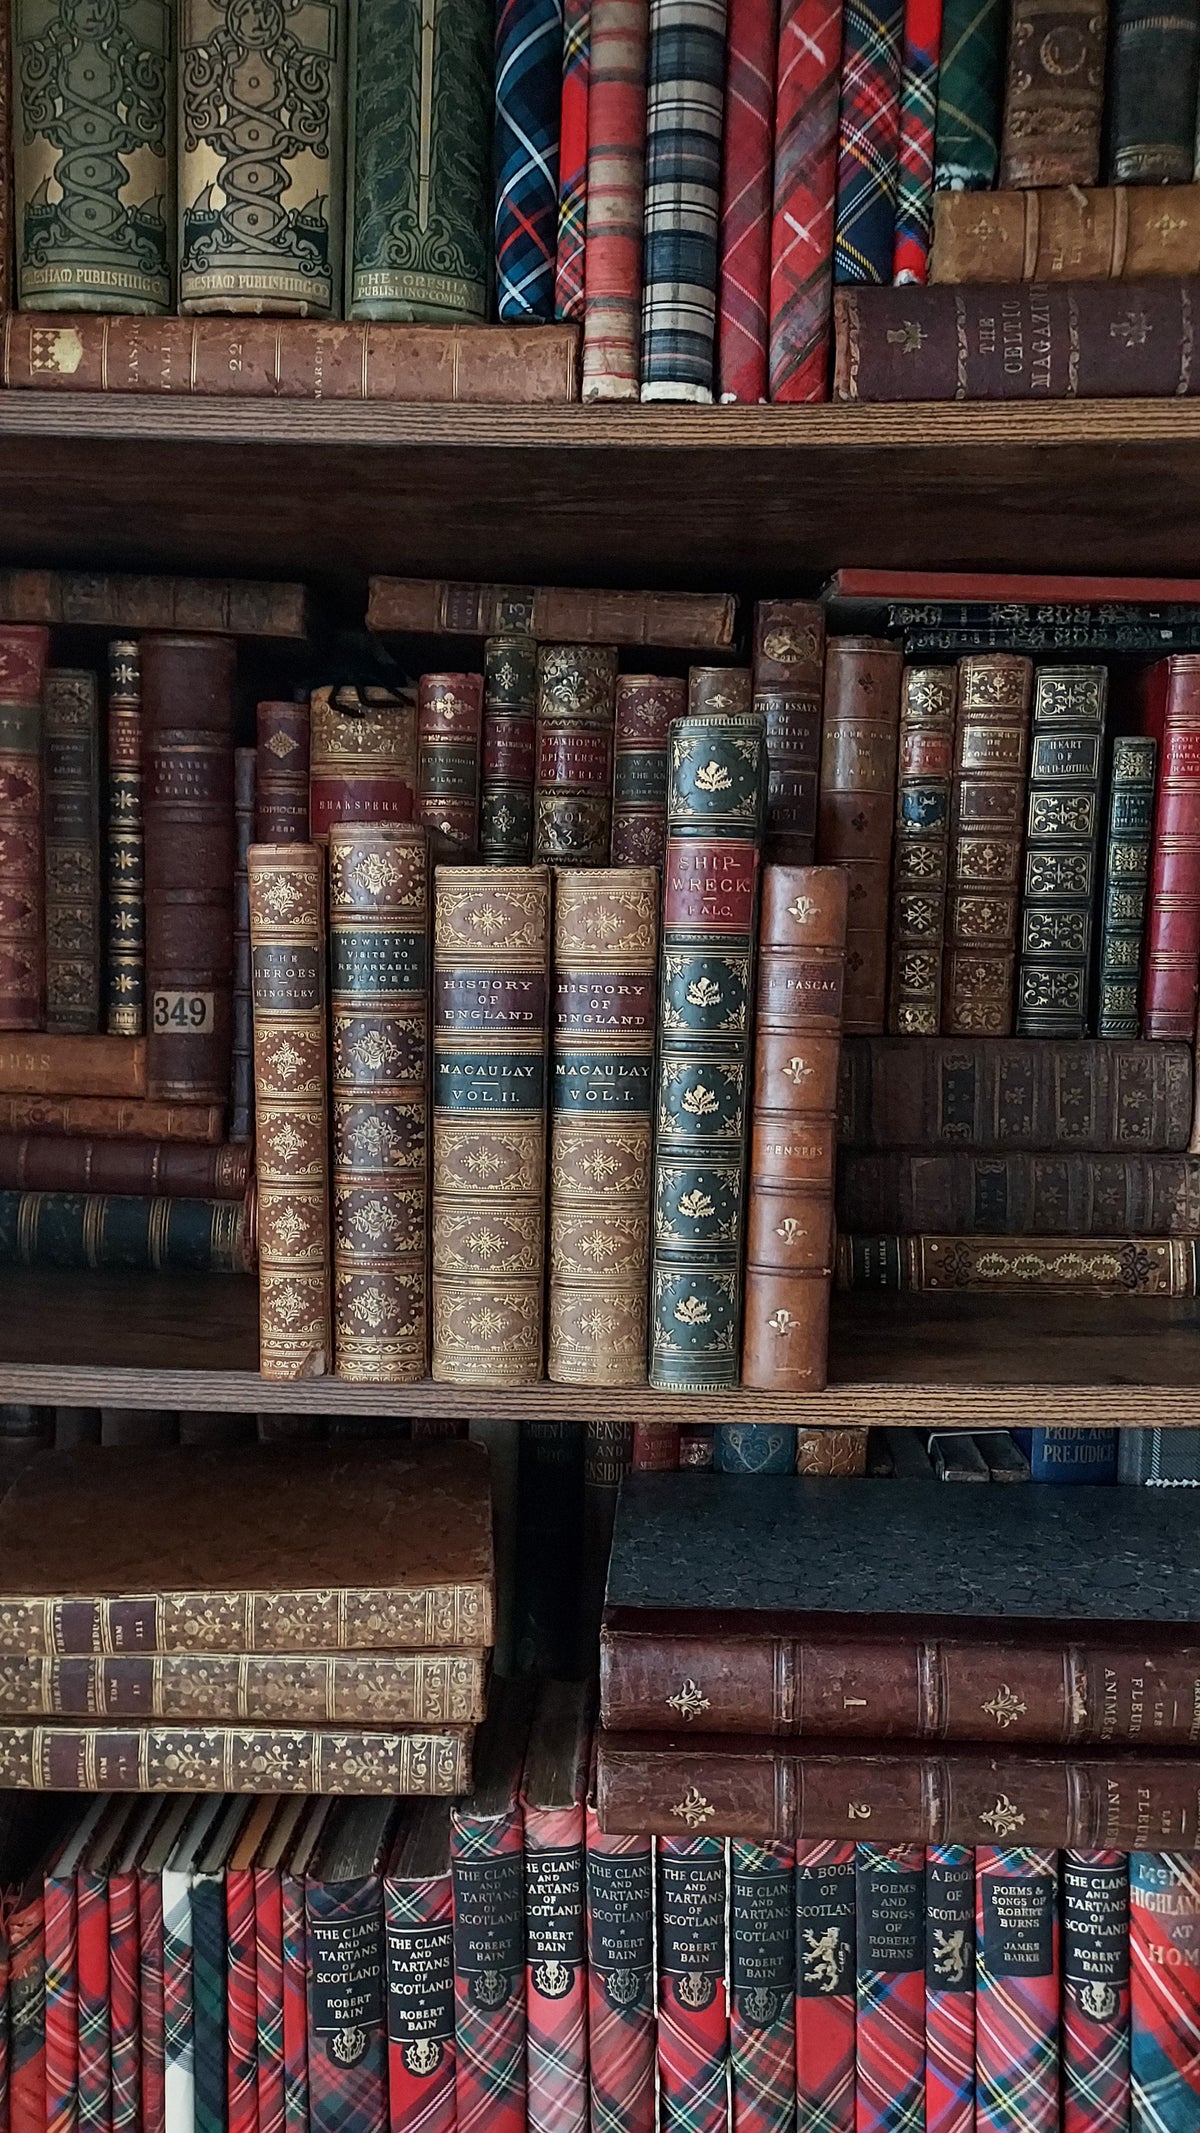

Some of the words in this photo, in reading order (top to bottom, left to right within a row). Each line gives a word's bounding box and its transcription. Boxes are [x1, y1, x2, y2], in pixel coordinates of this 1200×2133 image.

[76, 268, 150, 290] PUBLISHING
[239, 275, 311, 293] PUBLISHING
[358, 273, 391, 286] THE
[979, 318, 995, 354] THE
[1002, 300, 1023, 374] CELTIC
[229, 343, 242, 371] 22
[754, 702, 780, 712] PRIZE
[785, 702, 817, 713] ESSAYS
[778, 715, 790, 724] OF
[1050, 740, 1082, 750] HEART
[633, 758, 665, 768] WAR
[1057, 752, 1073, 762] OF
[631, 771, 649, 780] THE
[319, 800, 399, 811] SHAKSPERE
[679, 855, 741, 872] SHIP-
[688, 904, 734, 918] FALC.
[340, 937, 416, 947] HOWITT'S
[267, 953, 299, 964] THE
[347, 950, 386, 960] VISITS
[392, 950, 408, 960] TO
[254, 967, 317, 979] HEROES
[338, 962, 419, 972] REMARKABLE
[346, 973, 411, 984] PLACES
[443, 979, 534, 992] HISTORY
[557, 983, 646, 996] HISTORY
[787, 978, 837, 992] PASCAL
[256, 988, 316, 999] KINGSLEY
[477, 994, 500, 1006] OF
[590, 999, 612, 1010] OF
[154, 996, 207, 1027] 349
[444, 1009, 535, 1022] ENGLAND
[558, 1014, 647, 1026] ENGLAND
[439, 1063, 536, 1078] MACAULAY
[555, 1064, 651, 1078] MACAULAY
[588, 1421, 631, 1440] SENSE
[598, 1445, 623, 1457] AND
[1042, 1444, 1114, 1463] PREJUDICE
[135, 1620, 143, 1638] III
[115, 1625, 123, 1646] TOM
[110, 1679, 118, 1702] TOM
[133, 1684, 140, 1695] II
[843, 1696, 867, 1709] 1
[1128, 1677, 1143, 1740] FLEURS
[1153, 1702, 1164, 1727] LES
[848, 1802, 871, 1819] 2
[1161, 1809, 1171, 1834] LES
[542, 1858, 581, 1873] CLANS
[589, 1862, 612, 1878] THE
[801, 1867, 813, 1880] A
[817, 1863, 855, 1879] BOOK
[456, 1869, 480, 1881] THE
[537, 1874, 560, 1883] AND
[662, 1868, 686, 1881] THE
[690, 1869, 721, 1881] CLAN
[931, 1869, 941, 1881] A
[944, 1870, 974, 1883] BOO
[480, 1882, 501, 1890] AND
[610, 1880, 632, 1888] AND
[1065, 1873, 1088, 1888] THE
[1091, 1877, 1128, 1890] CLANS
[525, 1882, 579, 1895] ARTANS
[593, 1886, 651, 1901] TARTANS
[684, 1884, 707, 1892] AND
[820, 1884, 838, 1896] OF
[870, 1883, 917, 1894] POEMS
[992, 1885, 1033, 1896] POEMS
[1035, 1887, 1044, 1895] &
[460, 1888, 518, 1904] TARTANS
[543, 1896, 557, 1904] OF
[665, 1891, 725, 1904] TARTANS
[946, 1890, 963, 1901] OF
[991, 1896, 1027, 1906] SONGS
[1032, 1896, 1047, 1906] OF
[1085, 1891, 1109, 1899] AND
[615, 1903, 629, 1911] OF
[751, 1899, 774, 1907] AND
[880, 1897, 907, 1907] AND
[1065, 1895, 1127, 1913] TARTANS
[483, 1905, 495, 1913] OF
[526, 1904, 582, 1916] COTLAND
[688, 1906, 703, 1914] OF
[734, 1907, 791, 1920] TARTANS
[871, 1909, 915, 1919] SONGS
[927, 1906, 974, 1921] SCOTLAN
[997, 1907, 1043, 1916] ROBERT
[999, 1918, 1040, 1928] BURNS
[1090, 1913, 1104, 1922] OF
[314, 1930, 339, 1940] THE
[342, 1921, 380, 1940] CLANS
[754, 1921, 769, 1930] OF
[885, 1923, 902, 1933] OF
[1065, 1918, 1128, 1936] SCOTLAND
[1172, 1924, 1194, 1938] AT
[529, 1930, 574, 1941] ROBERT
[868, 1935, 917, 1946] ROBERT
[338, 1940, 360, 1949] AND
[388, 1937, 412, 1950] THE
[415, 1934, 452, 1949] CLANS
[468, 1940, 512, 1951] ROBERT
[537, 1942, 566, 1952] BAIN
[602, 1936, 645, 1948] ROBERT
[672, 1941, 718, 1951] ROBERT
[1003, 1942, 1040, 1951] JAMES
[319, 1943, 378, 1961] TARTANS
[410, 1950, 432, 1960] AND
[476, 1952, 505, 1962] BAIN
[608, 1950, 637, 1960] BAIN
[680, 1953, 711, 1963] BAIN
[871, 1948, 914, 1959] BURNS
[1003, 1952, 1040, 1962] BARKE
[1073, 1947, 1121, 1961] ROBERT
[342, 1963, 356, 1971] OF
[392, 1957, 450, 1972] TARTANS
[738, 1956, 784, 1967] ROBERT
[1082, 1961, 1114, 1974] BAIN
[316, 1965, 380, 1983] SCOTLAND
[414, 1973, 428, 1982] OF
[746, 1968, 776, 1979] BAIN
[390, 1978, 454, 1995] SCOTLAND
[327, 1994, 372, 2008] ROBERT
[335, 2006, 364, 2020] BAIN
[400, 2006, 445, 2020] ROBERT
[407, 2019, 438, 2031] BAIN
